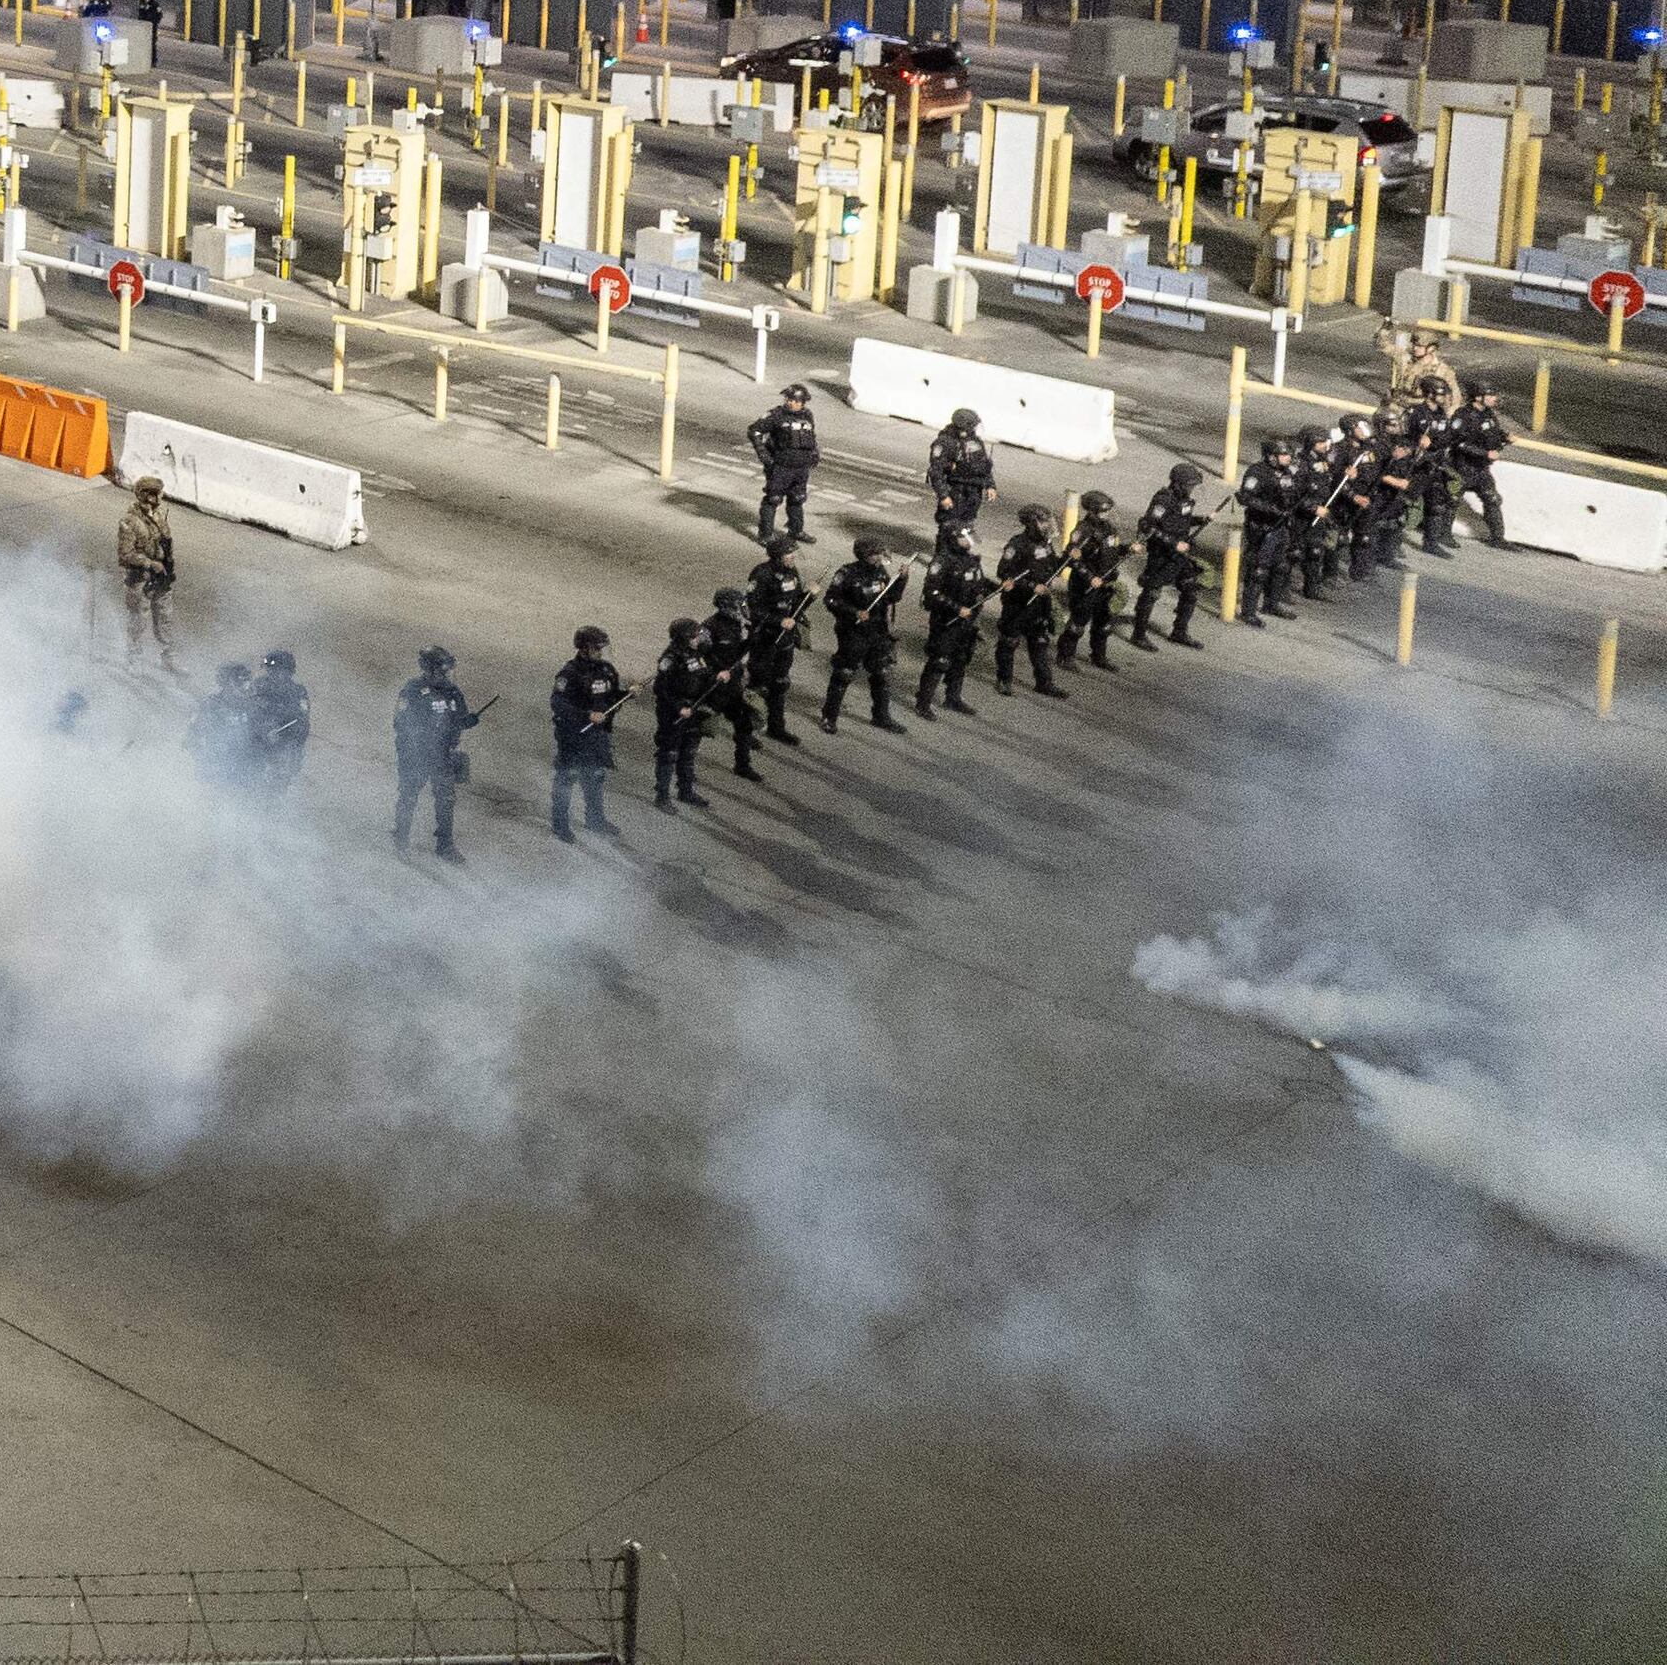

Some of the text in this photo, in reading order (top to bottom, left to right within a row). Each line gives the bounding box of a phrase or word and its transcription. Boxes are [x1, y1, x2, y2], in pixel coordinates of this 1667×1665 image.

[117, 272, 136, 284] STOP
[599, 277, 621, 289] STOP
[1087, 276, 1113, 288] STOP
[1602, 283, 1631, 295] STOP
